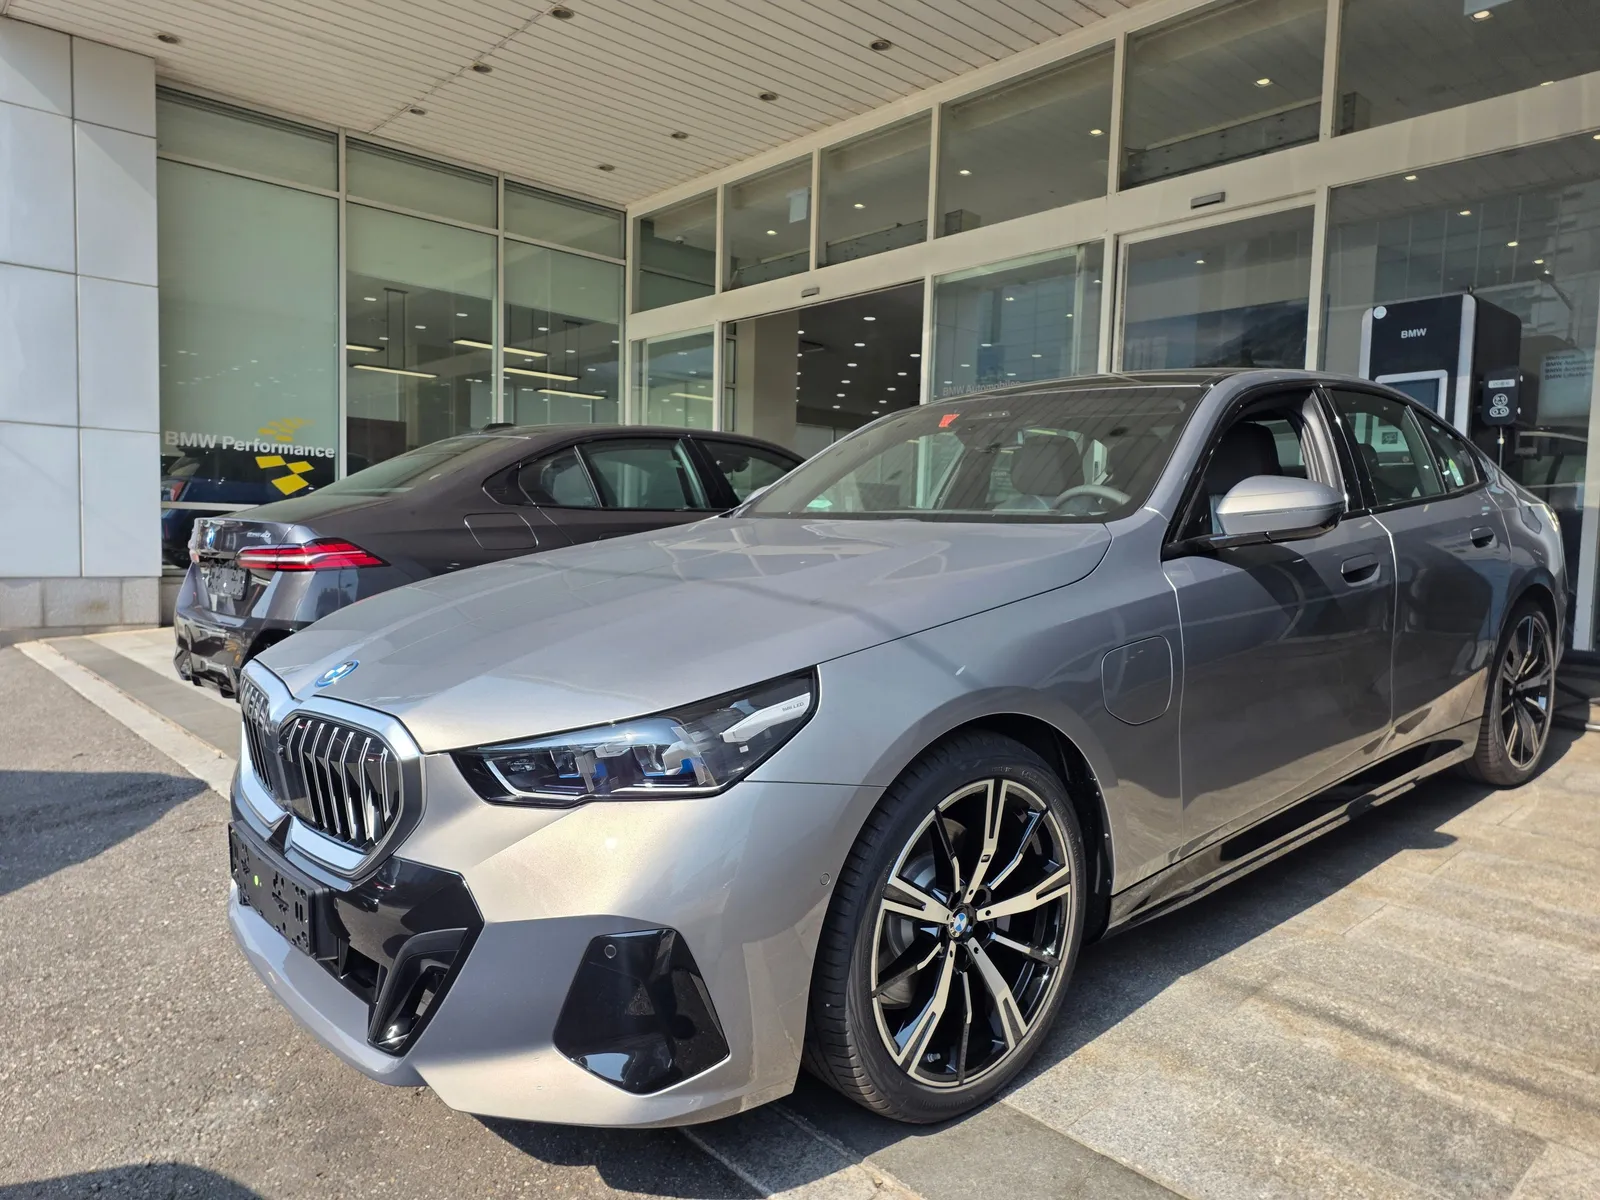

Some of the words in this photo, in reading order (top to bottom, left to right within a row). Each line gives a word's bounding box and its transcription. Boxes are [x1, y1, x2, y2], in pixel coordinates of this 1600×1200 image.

[1401, 328, 1427, 339] BMW
[942, 386, 964, 397] BMW
[164, 430, 217, 449] BMW
[221, 435, 336, 459] Performance
